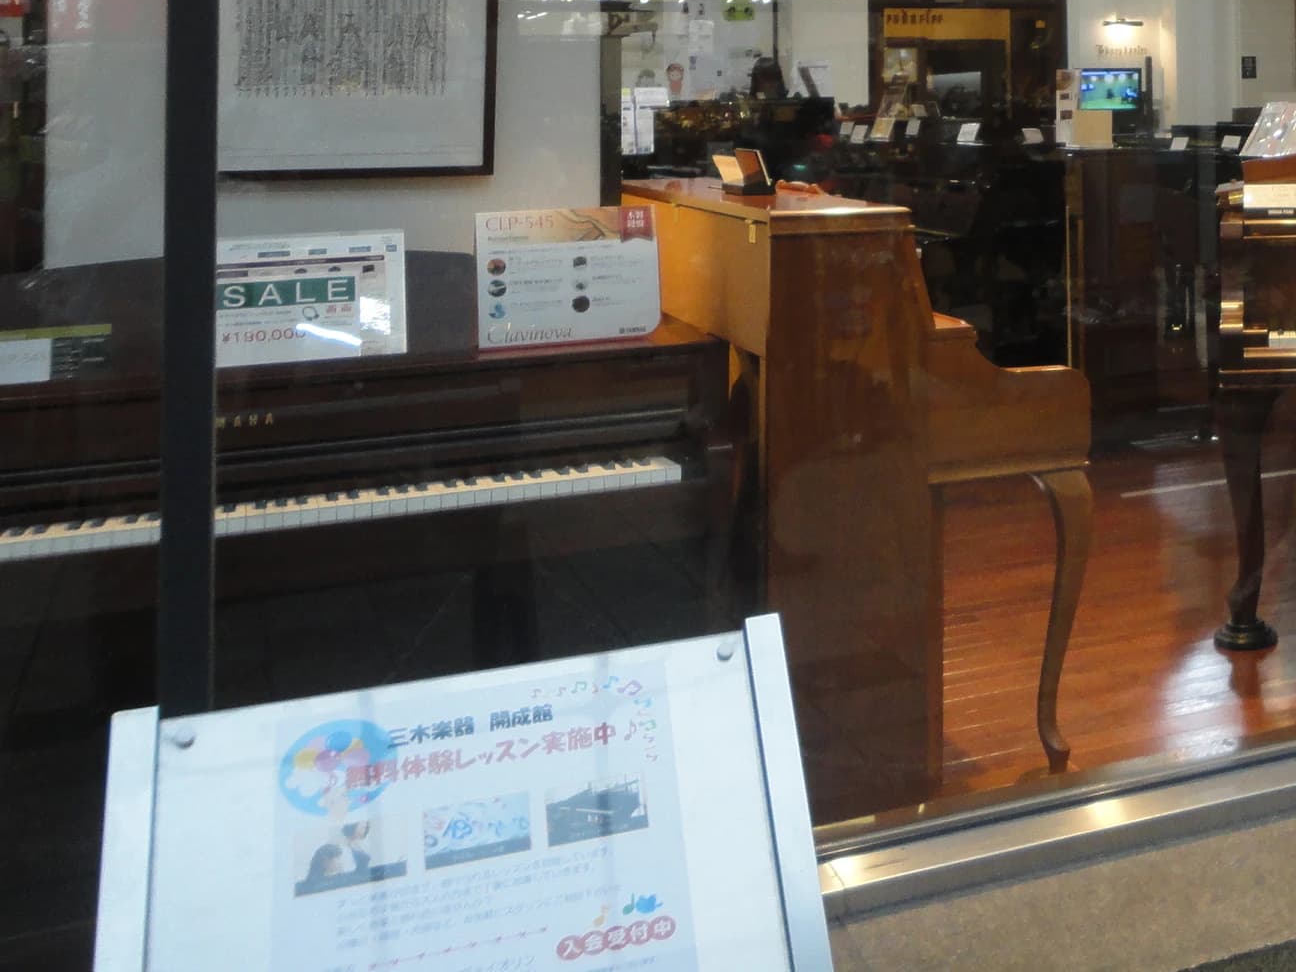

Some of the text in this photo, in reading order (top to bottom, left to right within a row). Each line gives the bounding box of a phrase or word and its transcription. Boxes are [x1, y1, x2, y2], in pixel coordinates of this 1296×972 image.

[222, 278, 350, 308] SALE
[487, 322, 573, 345] Clavinova
[387, 704, 553, 749] 三木楽器 開成館
[562, 920, 672, 959] 入会受付中
